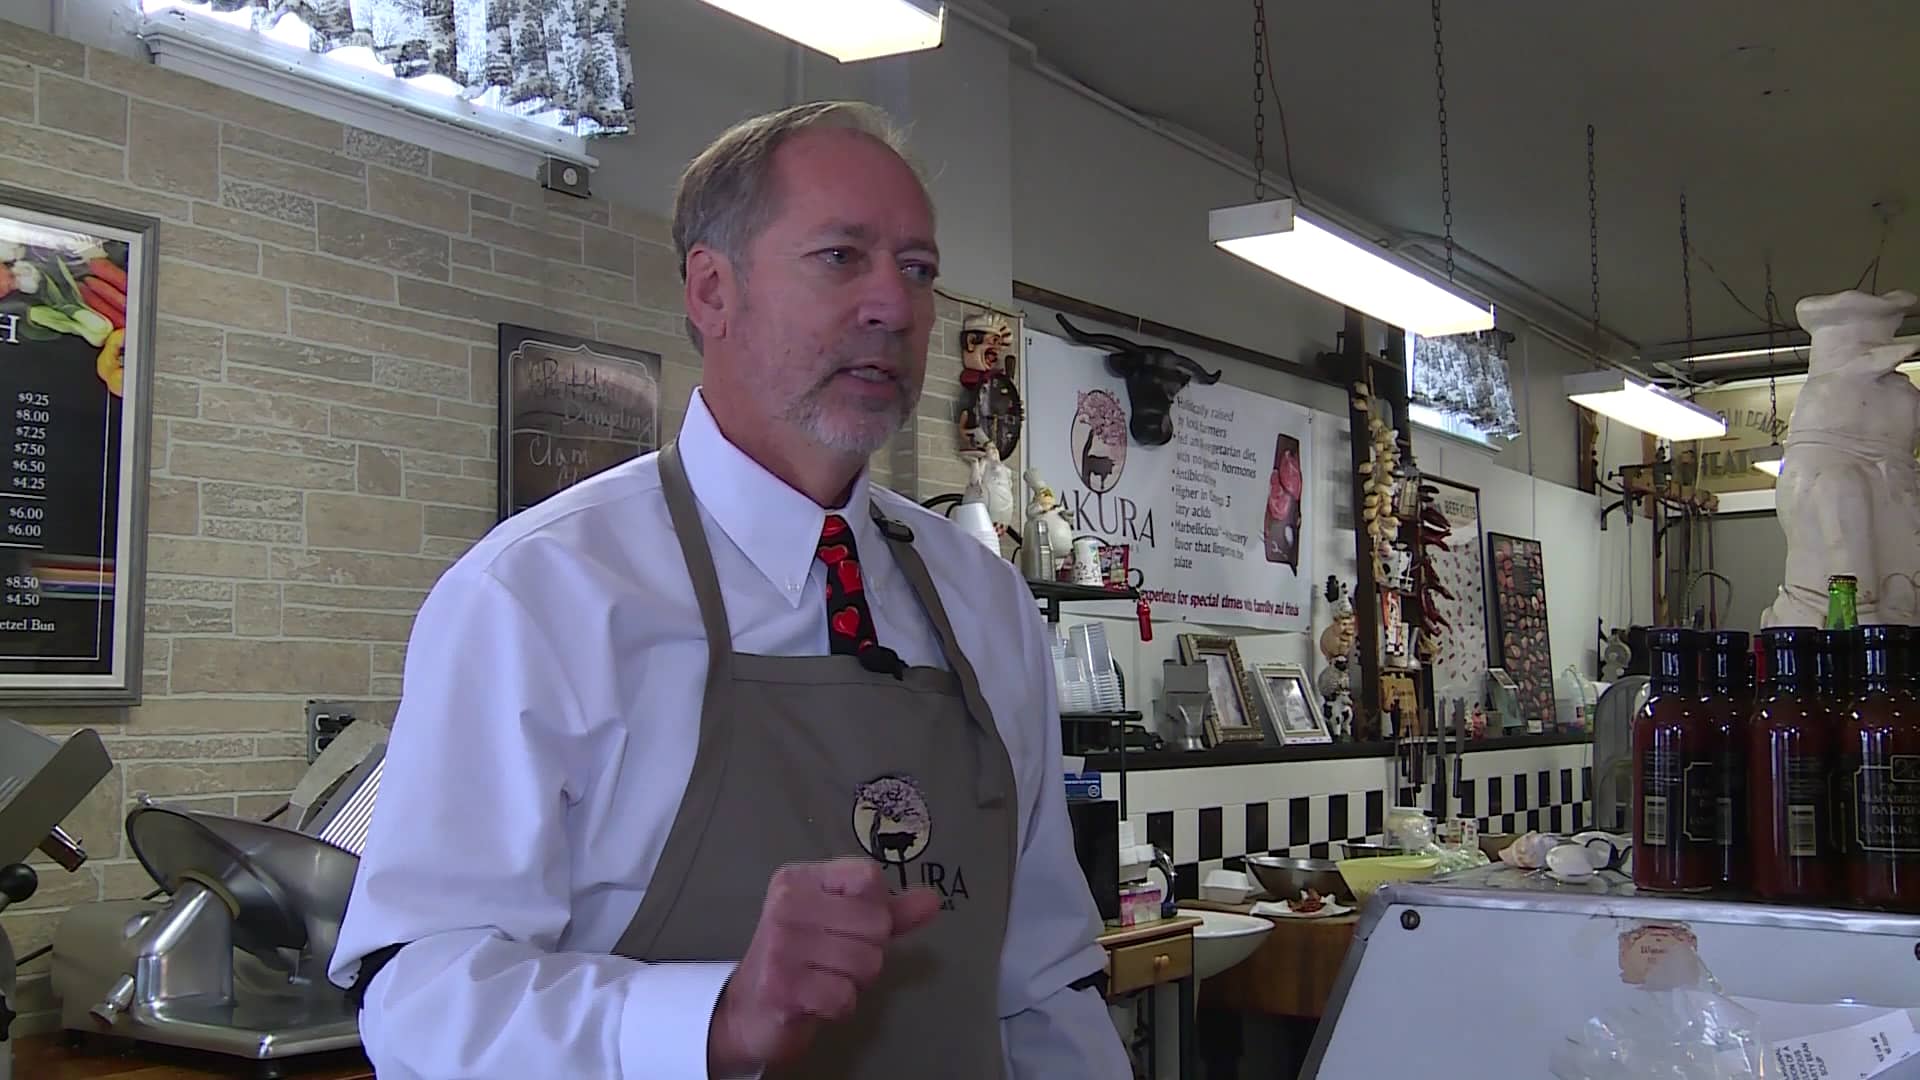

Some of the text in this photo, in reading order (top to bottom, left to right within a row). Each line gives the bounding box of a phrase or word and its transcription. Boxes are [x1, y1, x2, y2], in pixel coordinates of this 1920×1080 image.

[18, 392, 49, 406] $9.25
[16, 409, 49, 423] $8.00
[16, 426, 46, 439] $7.25
[14, 443, 46, 456] $7.50
[13, 460, 46, 473] $6.50
[13, 477, 45, 490] $4.25
[9, 506, 44, 520] $6.00
[1058, 489, 1155, 548] AKURA
[7, 524, 41, 537] $6.00
[1194, 540, 1211, 553] that
[6, 576, 39, 589] $8.50
[6, 594, 40, 606] $4.50
[1178, 590, 1188, 605] for
[1190, 593, 1220, 608] special
[31, 618, 55, 632] Bun
